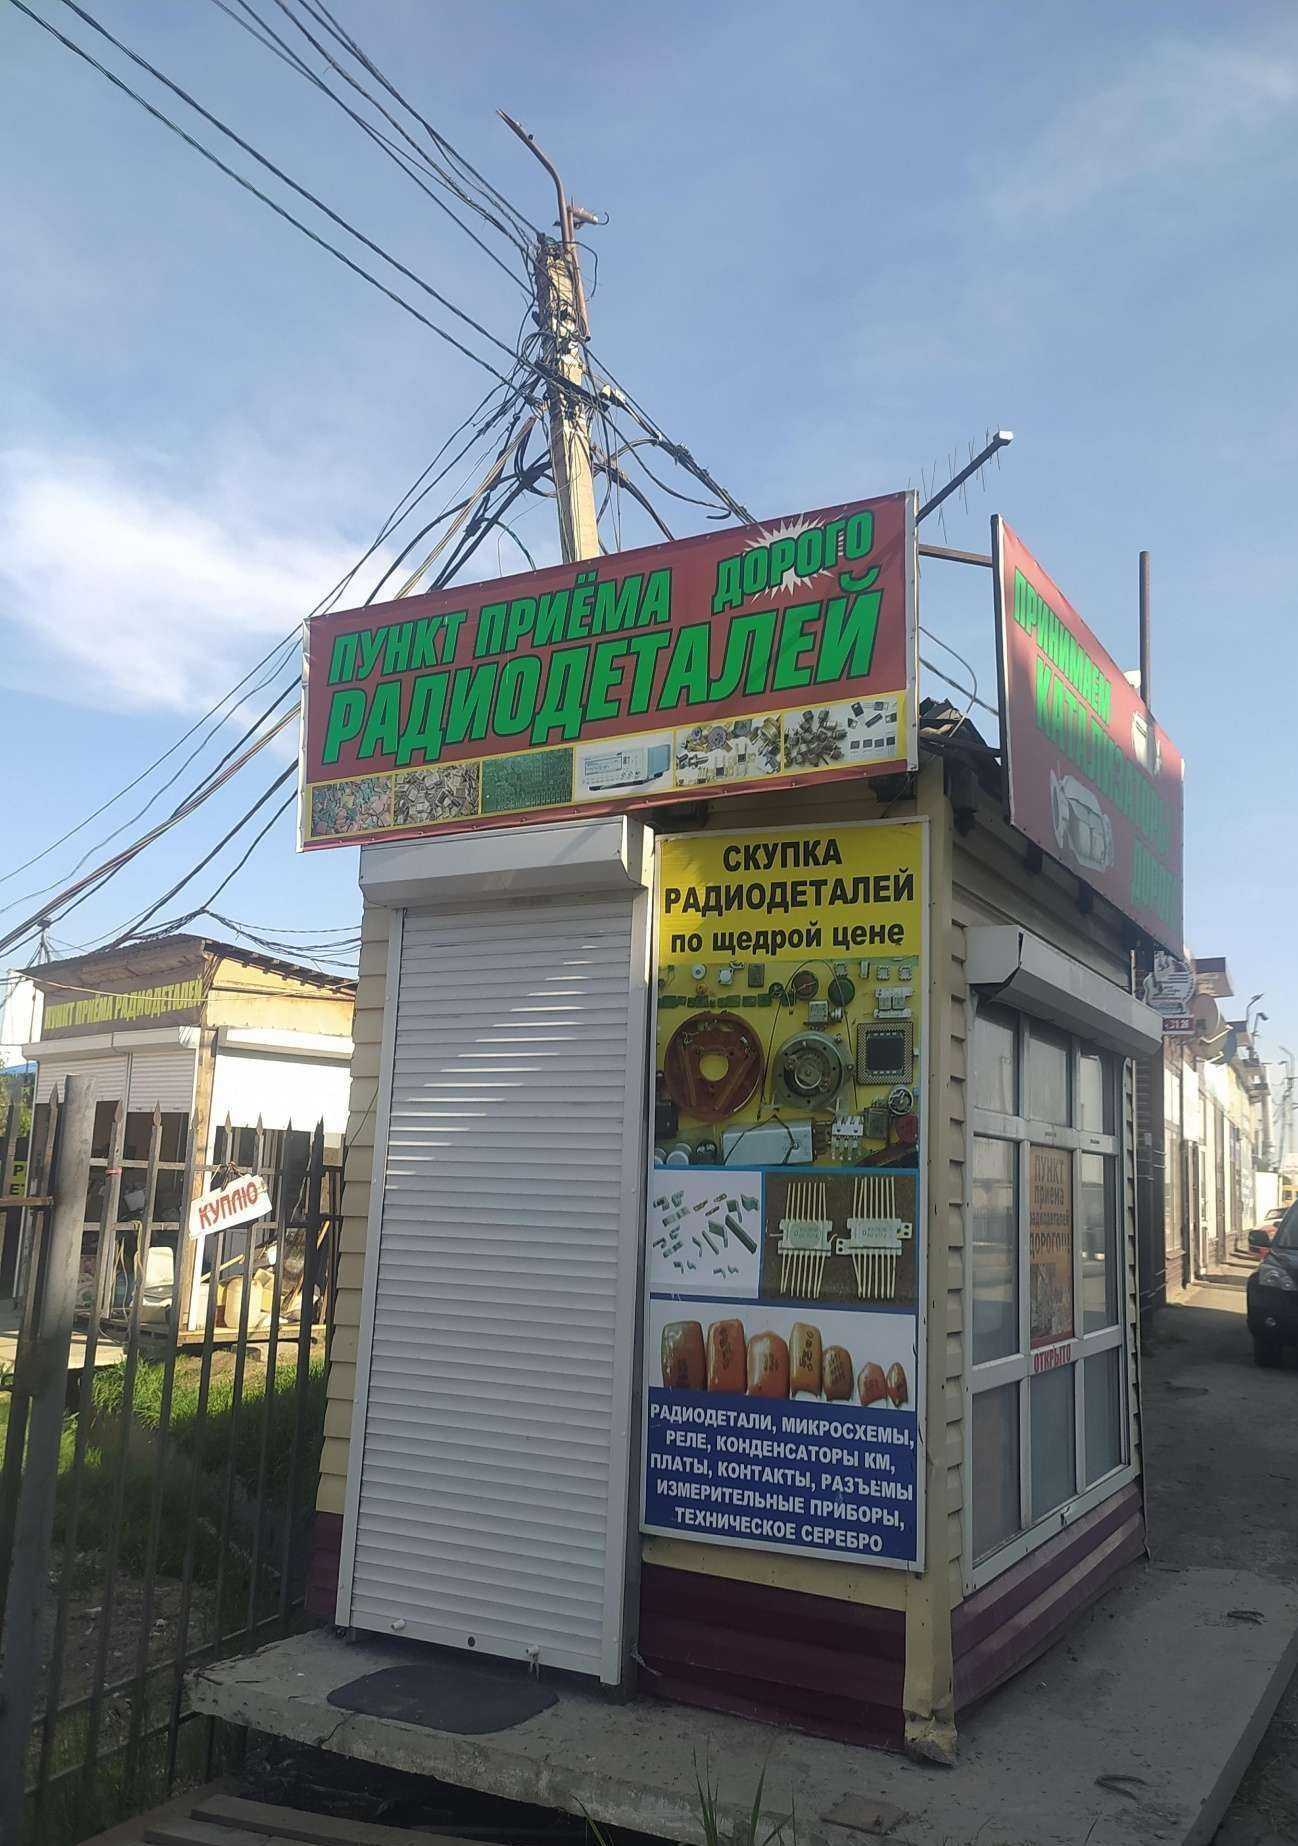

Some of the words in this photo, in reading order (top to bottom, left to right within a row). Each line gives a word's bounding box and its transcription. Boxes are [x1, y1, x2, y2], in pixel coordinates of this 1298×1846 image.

[711, 508, 875, 614] ДОРОГО
[327, 609, 468, 686] ПУНКТ
[475, 568, 673, 658] ПРИЁМА
[1013, 565, 1112, 728] ПРИНИМАЕМ
[321, 565, 884, 766] РАДИОДЕТАЛЕЙ
[722, 838, 843, 872] СКУПКА
[664, 867, 914, 917] РАДИОДЕТАЛЕЙ
[671, 931, 703, 953] по
[712, 920, 822, 956] щедрой
[832, 923, 905, 951] цене
[1034, 1154, 1064, 1185] ПУНКТ
[198, 1181, 258, 1230] КУПЛЮ
[1033, 1343, 1071, 1373] ОТКРЫТО
[650, 1403, 777, 1434] РАДИОДЕТАЛИ,
[781, 1416, 915, 1449] МИКРОСХЕМЫ,
[650, 1453, 713, 1478] ПЛАТЫ,
[717, 1461, 816, 1492] КОНТАКТЫ,
[665, 1430, 711, 1454] РЕЛЕ,
[716, 1434, 859, 1467] КОНДЕНСАТОРЫ
[864, 1451, 896, 1475] КМ,
[656, 1478, 805, 1515] ИЗМЕРИТЕЛЬНЫЕ
[809, 1499, 905, 1531] ПРИБОРЫ,
[675, 1506, 797, 1540] ТЕХНИЧЕСКОЕ
[801, 1524, 883, 1552] СЕРЕБРО
